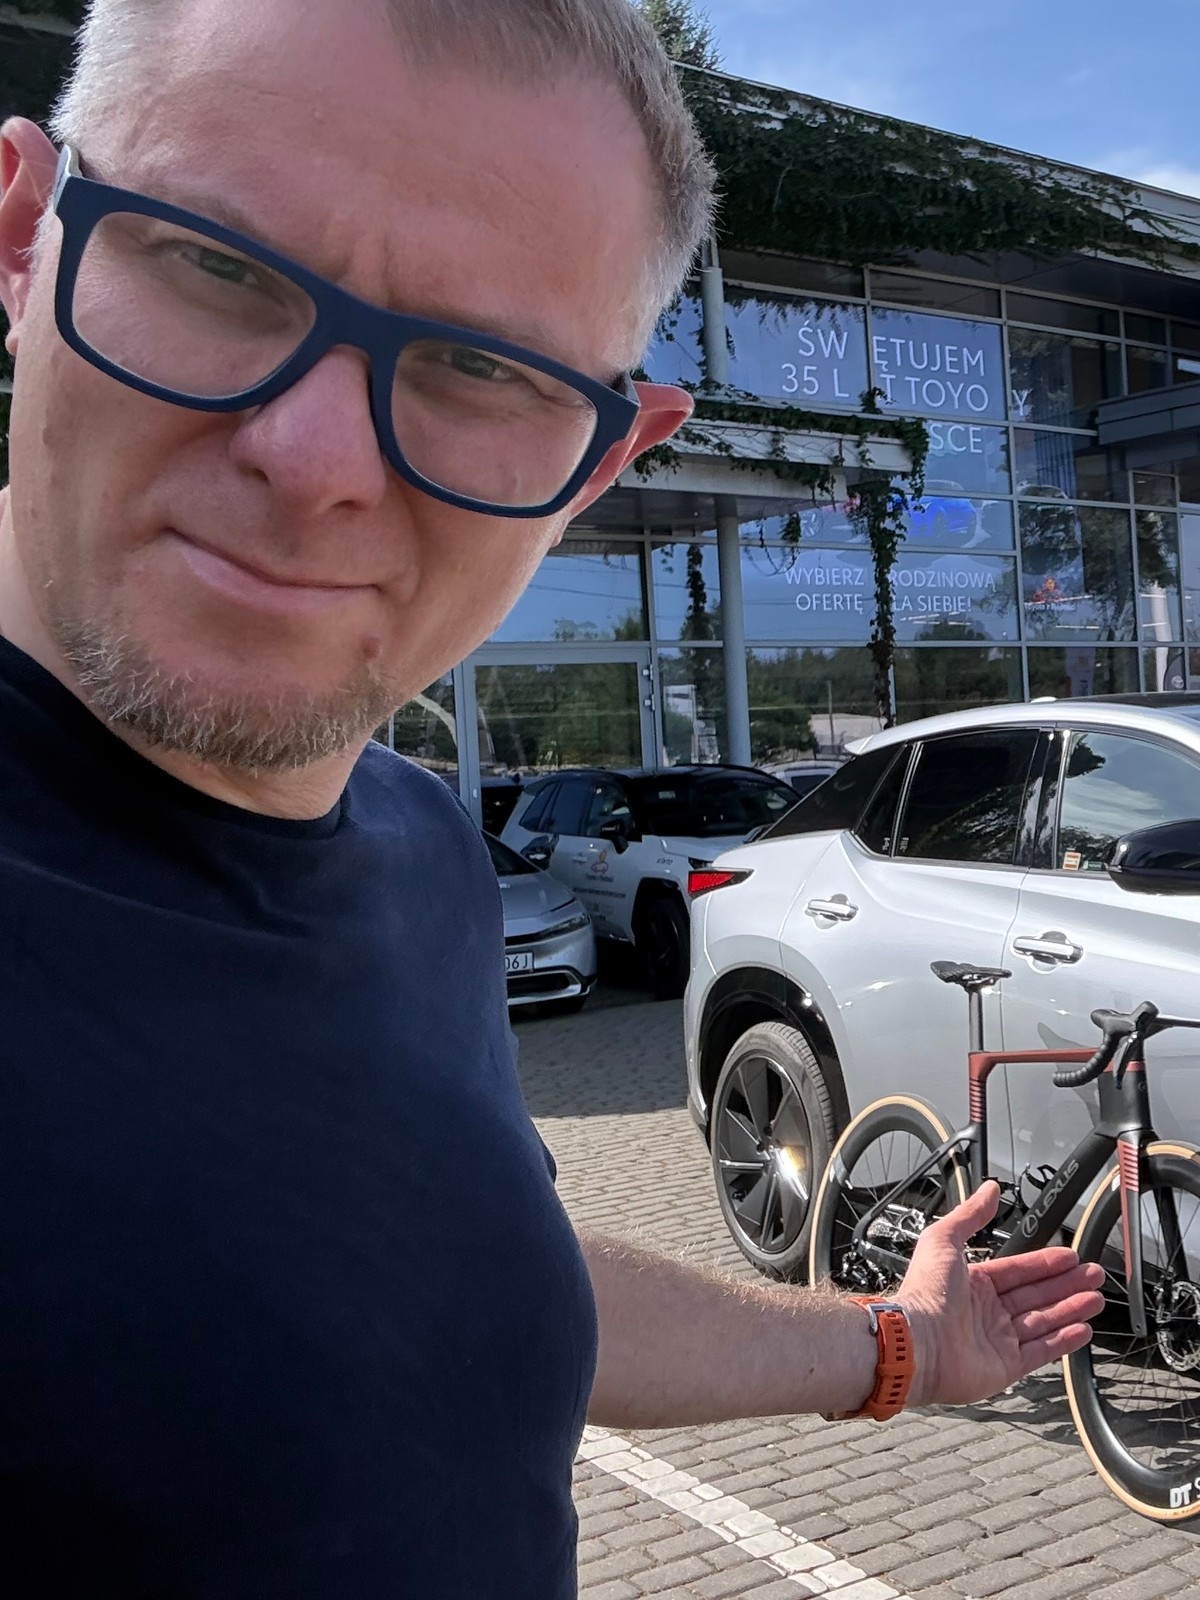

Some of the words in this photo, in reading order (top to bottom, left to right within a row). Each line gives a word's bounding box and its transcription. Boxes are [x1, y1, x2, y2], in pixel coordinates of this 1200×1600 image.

[798, 321, 985, 377] ŚWĘTUJEM
[781, 362, 819, 396] 35
[834, 368, 896, 402] LT
[905, 376, 1030, 417] TOYOY
[929, 423, 984, 454] SCE
[784, 567, 865, 586] WYBIERZ
[889, 568, 997, 593] RODZINOWĄ
[796, 592, 864, 616] OFERTĘ
[891, 595, 913, 612] LA
[918, 595, 972, 613] SIEBIE!
[504, 955, 528, 970] 06J
[1035, 1159, 1080, 1218] LEXUS
[1169, 1482, 1192, 1508] DT
